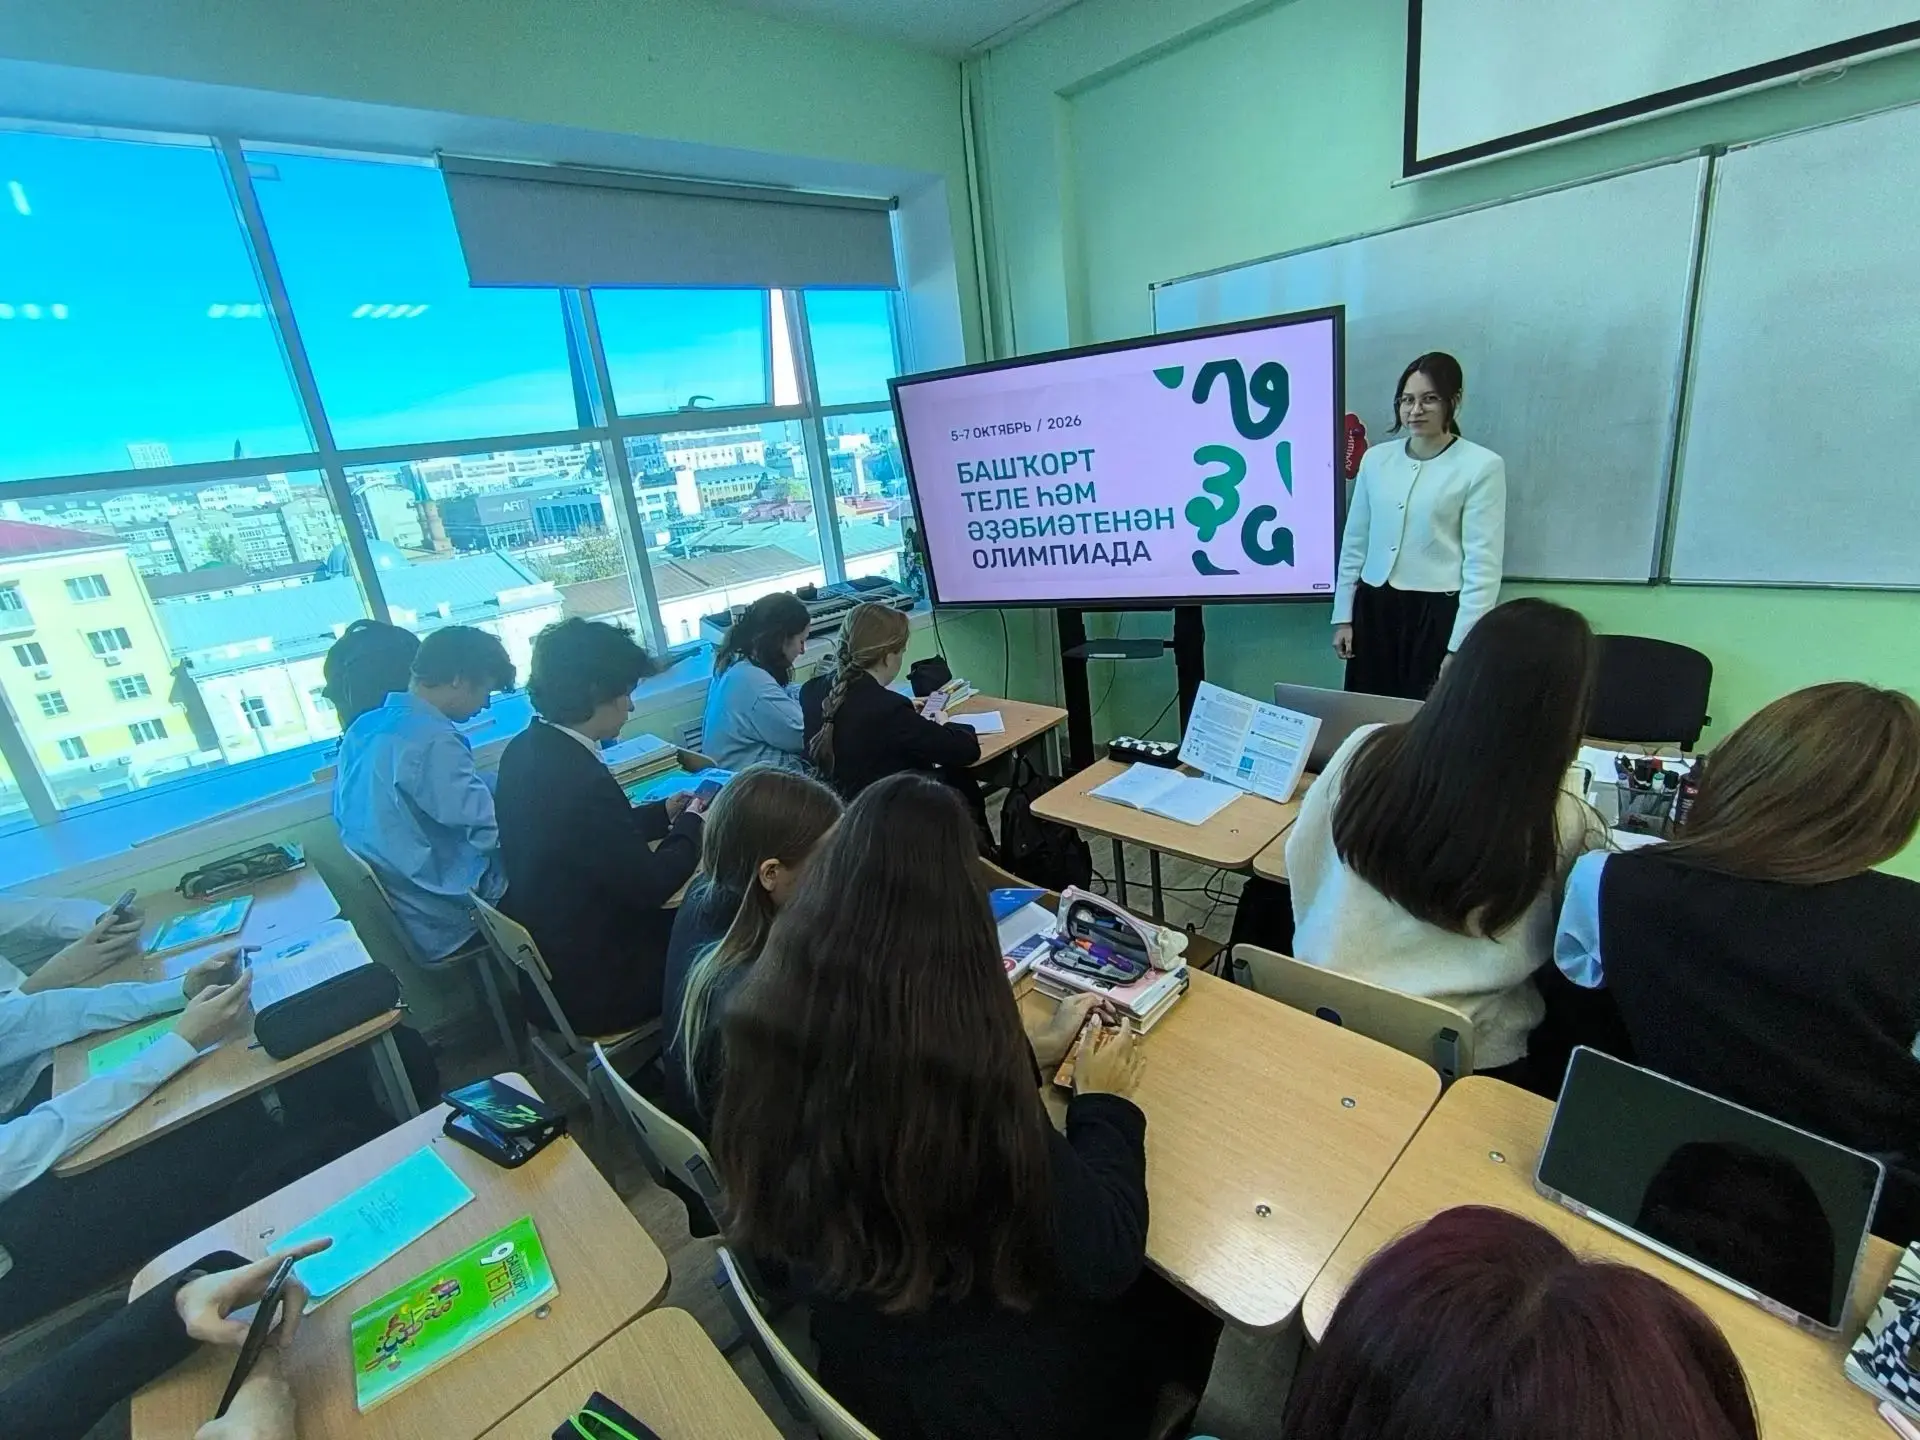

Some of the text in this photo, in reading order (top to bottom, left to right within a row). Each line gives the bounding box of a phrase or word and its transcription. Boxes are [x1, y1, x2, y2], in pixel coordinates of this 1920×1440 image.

[951, 429, 970, 441] 5-7
[973, 421, 1032, 439] ОКТЯБРЬ
[1047, 414, 1082, 430] 2026
[956, 448, 1096, 484] БАШҠОРТ
[503, 500, 524, 512] ART
[960, 487, 1030, 513] ТЕЛЕ
[967, 506, 1175, 544] ӘҘӘБИӘТЕНӘН
[972, 540, 1153, 569] ОЛИМПИАДА
[480, 1241, 515, 1266] 9
[485, 1260, 515, 1309] ТЕЛЕ
